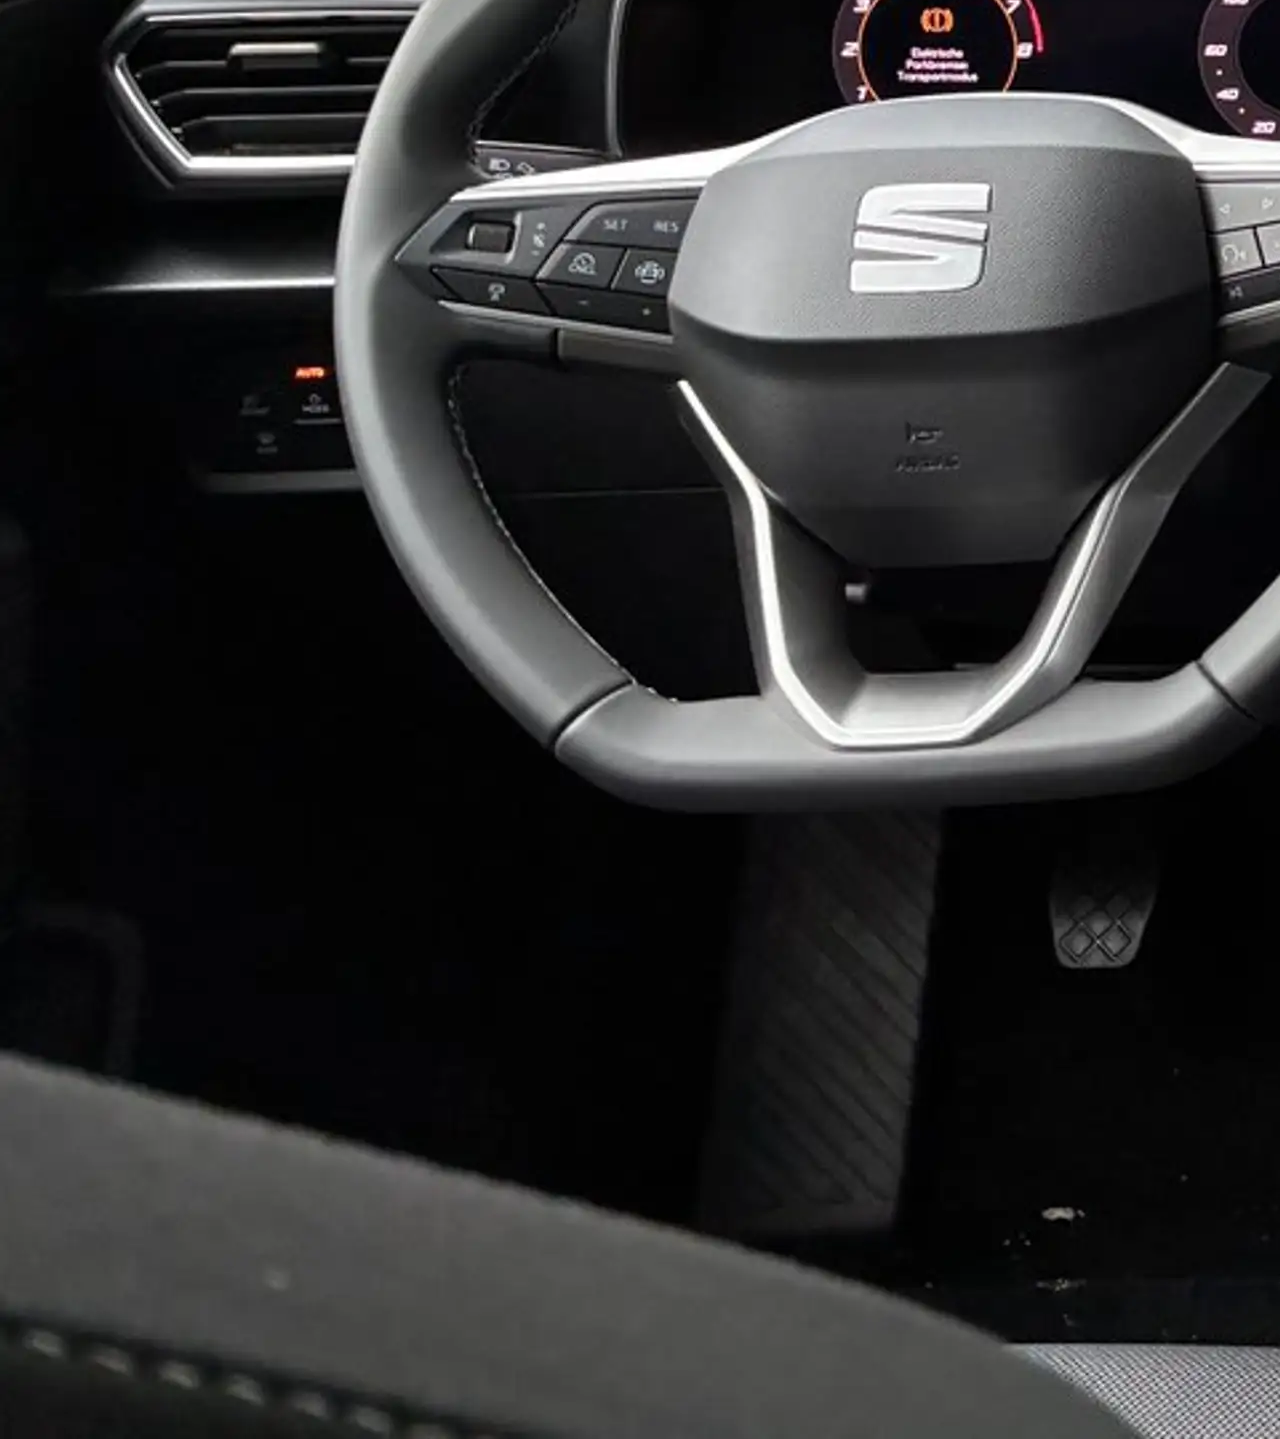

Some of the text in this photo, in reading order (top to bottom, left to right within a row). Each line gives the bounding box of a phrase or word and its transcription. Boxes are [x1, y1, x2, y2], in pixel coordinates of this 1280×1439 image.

[1006, 0, 1021, 13] 7
[840, 42, 859, 57] 2
[1017, 42, 1034, 58] 8
[1204, 44, 1228, 56] 60
[856, 86, 867, 100] 1
[1216, 88, 1240, 100] 40
[1251, 120, 1276, 134] 20
